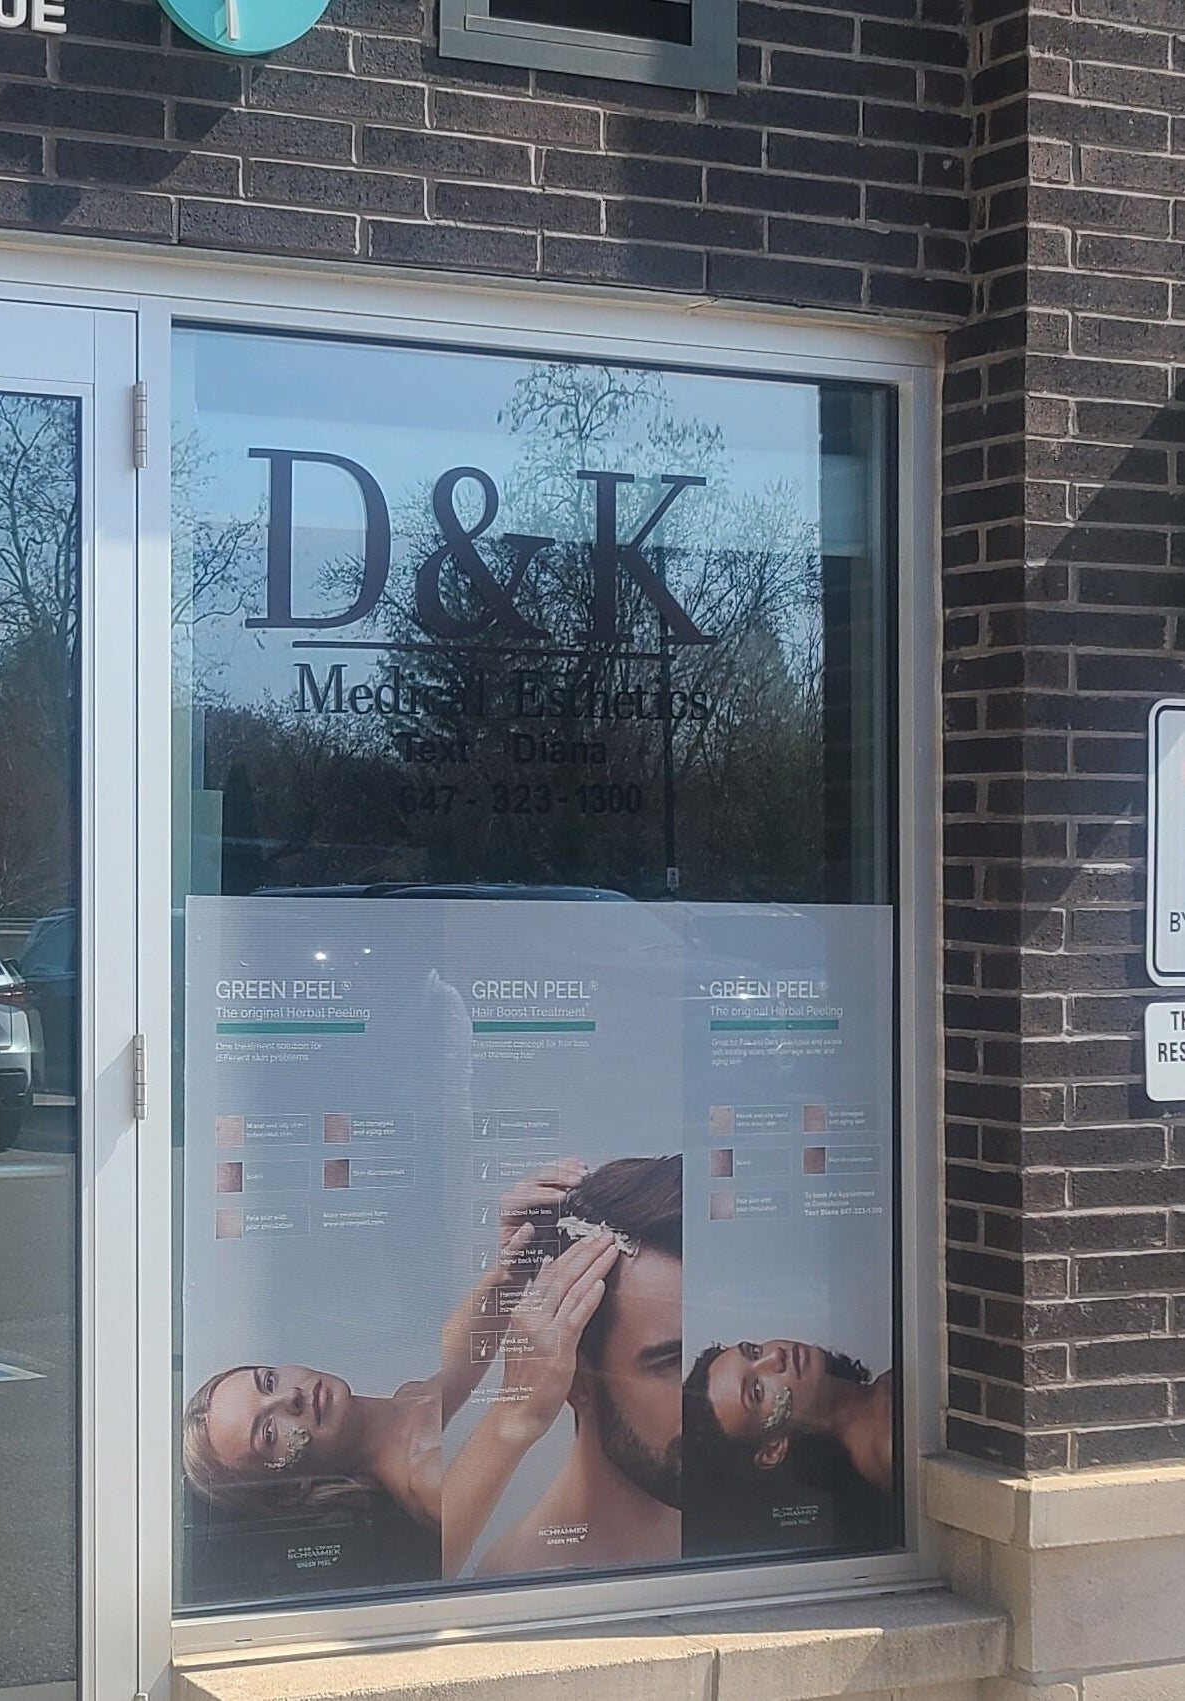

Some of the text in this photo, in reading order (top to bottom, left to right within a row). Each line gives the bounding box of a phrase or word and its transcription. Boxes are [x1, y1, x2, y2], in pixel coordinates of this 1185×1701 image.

[293, 662, 710, 722] Medical Esthetics
[393, 731, 608, 765] Text Diana
[1169, 911, 1185, 933] B
[215, 979, 287, 1000] GREEN
[471, 980, 538, 1000] GREEN
[709, 980, 771, 999] GREEN
[215, 1006, 371, 1021] The original Herbal Peeling
[471, 1006, 494, 1018] Hair
[496, 1006, 527, 1018] Boost
[710, 1005, 729, 1017] The
[731, 1005, 768, 1018] original
